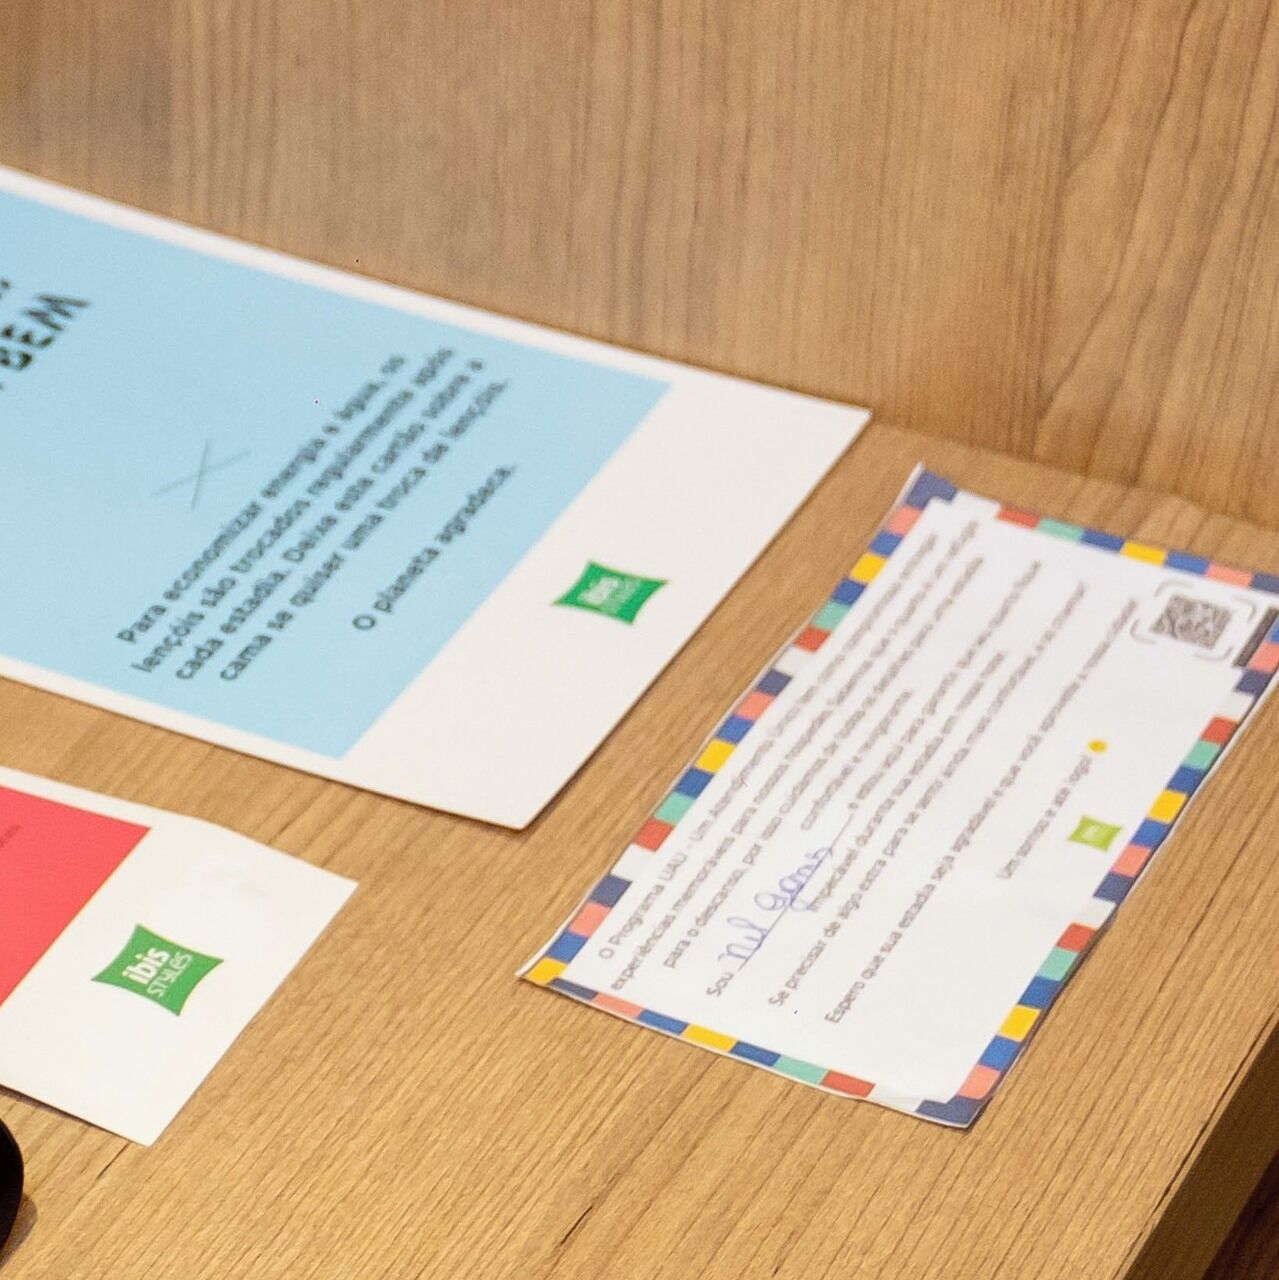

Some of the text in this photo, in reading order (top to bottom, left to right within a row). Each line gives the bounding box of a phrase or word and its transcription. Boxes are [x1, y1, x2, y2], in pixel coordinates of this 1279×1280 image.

[115, 603, 168, 643] Para
[159, 500, 265, 601] economizar
[258, 437, 329, 499] energia
[322, 424, 340, 435] e
[130, 610, 207, 673] lençóis
[196, 576, 237, 608] são
[228, 499, 311, 573] trocados
[304, 390, 417, 497] regularmente
[173, 637, 225, 680] cada
[216, 568, 291, 634] estadia.
[281, 514, 339, 563] Deixe
[332, 477, 375, 511] este
[366, 421, 427, 474] cartão
[219, 634, 273, 681] cama
[266, 610, 295, 630] se
[287, 551, 349, 608] quiser
[342, 513, 385, 550] uma
[375, 466, 427, 510] troca
[420, 442, 450, 464] de
[350, 614, 378, 630] O
[371, 547, 442, 613] planeta
[596, 947, 616, 960] O
[606, 883, 666, 946] Programa
[609, 913, 677, 991] experiências
[670, 836, 737, 912] memoráveis
[729, 806, 758, 835] para
[662, 939, 692, 969] para
[685, 927, 700, 937] o
[693, 867, 748, 927] descanso,
[741, 843, 764, 865] por
[997, 856, 1021, 880] Um
[121, 946, 171, 984] ibis
[704, 970, 735, 997] Sou
[767, 989, 791, 1006] Se
[783, 939, 828, 989] precisar
[822, 920, 842, 938] de
[823, 980, 867, 1023] Espero
[860, 954, 886, 980] que
[878, 931, 903, 953] sua
[896, 882, 937, 929] estadia
